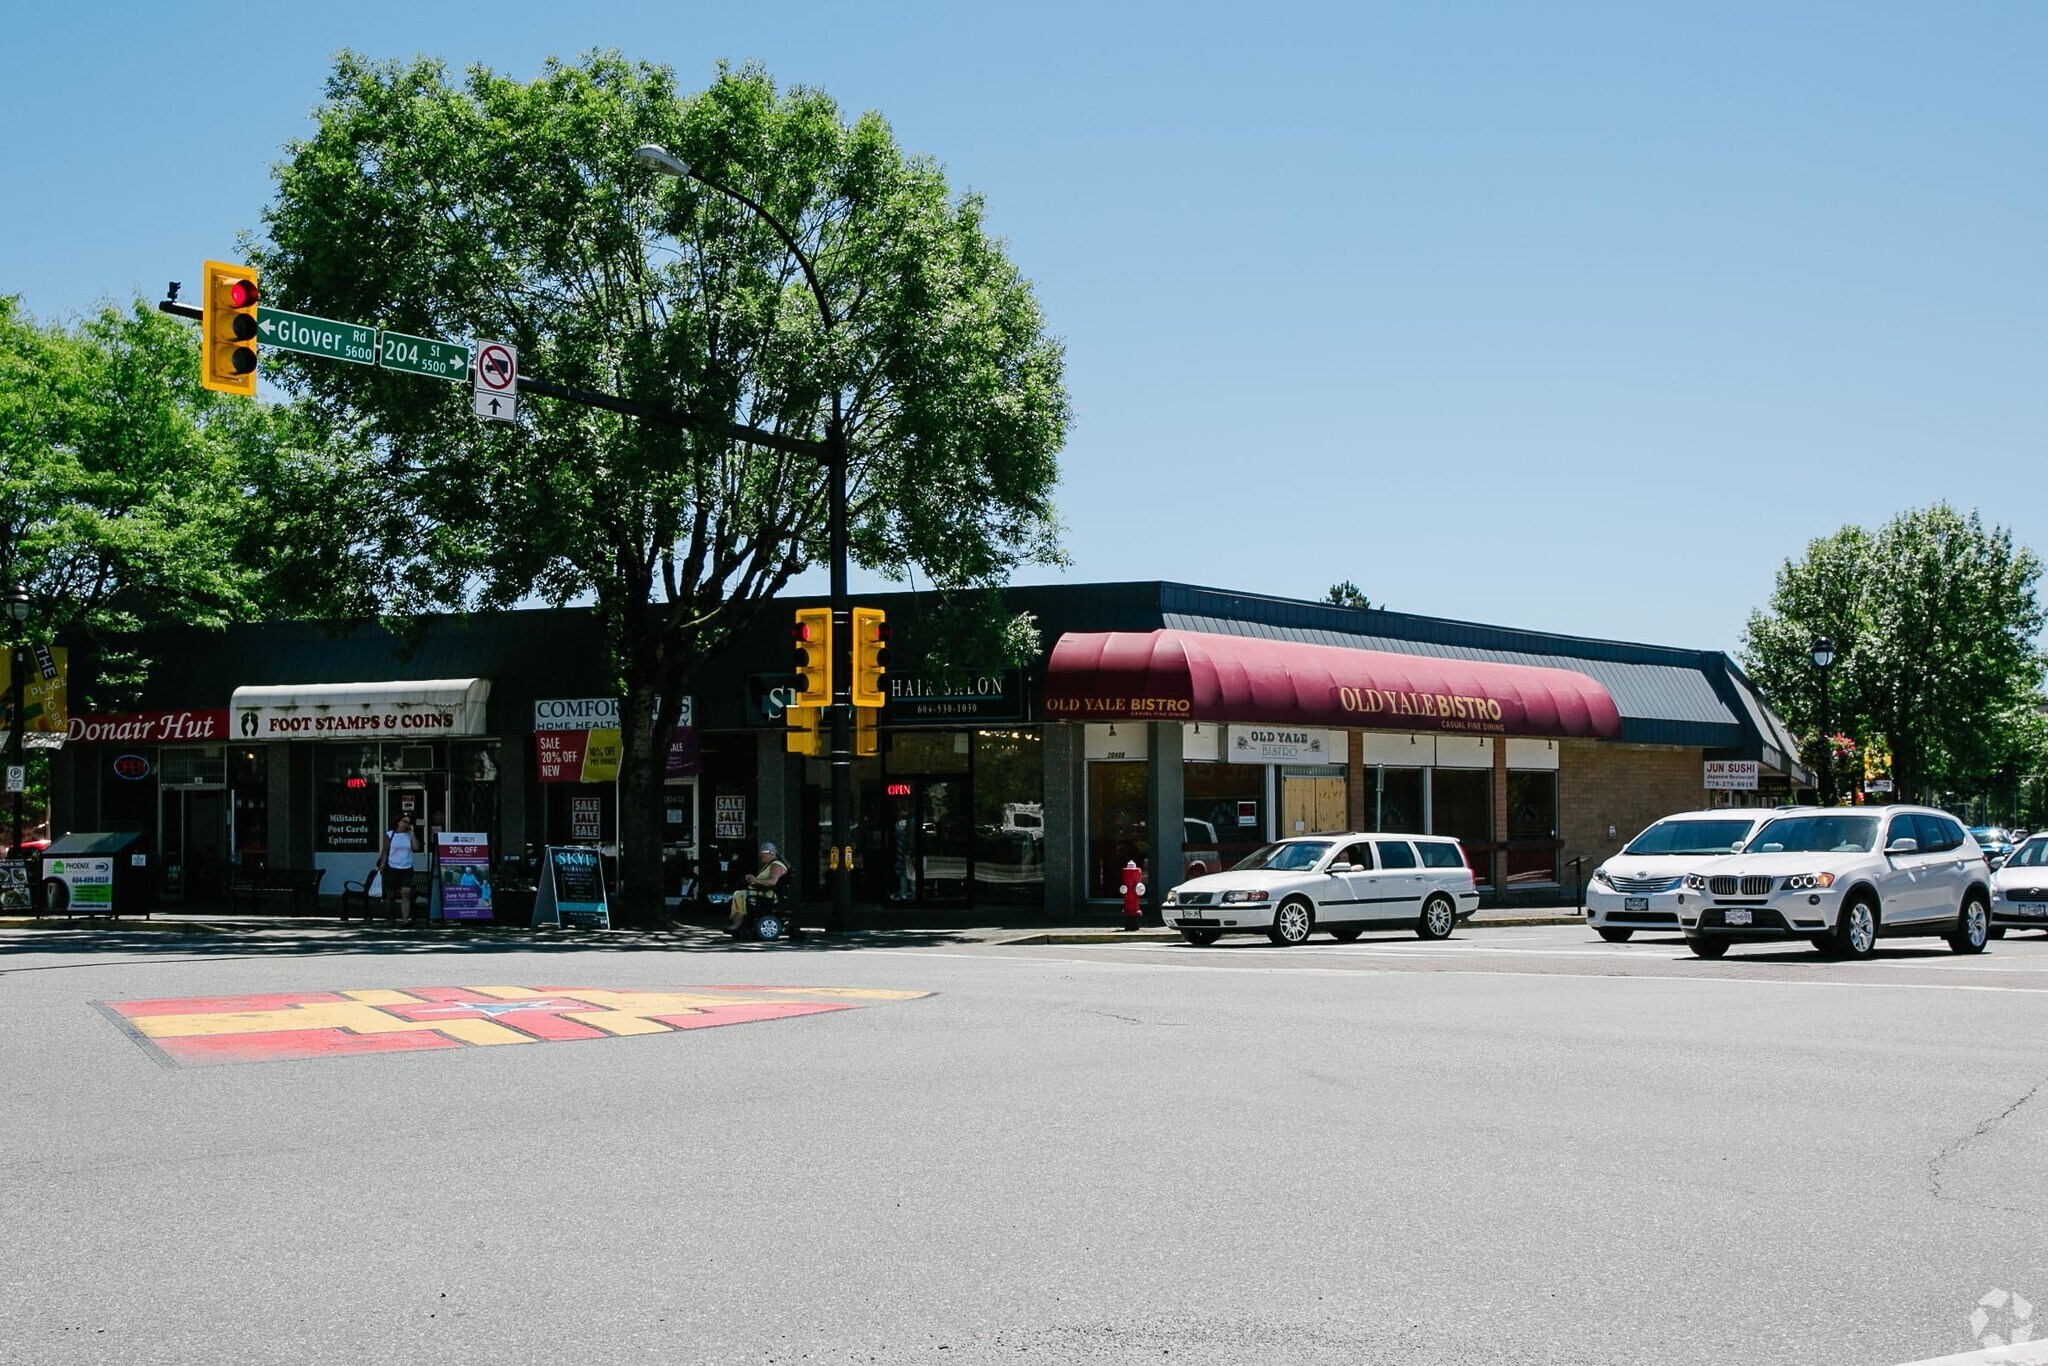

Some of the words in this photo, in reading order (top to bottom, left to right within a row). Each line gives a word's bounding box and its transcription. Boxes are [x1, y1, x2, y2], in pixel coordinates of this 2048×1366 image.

[278, 320, 342, 352] Glover
[353, 330, 366, 344] Rd
[345, 344, 372, 361] 5600
[385, 340, 418, 364] 204
[430, 344, 441, 357] St
[422, 358, 446, 374] 5500
[36, 645, 56, 678] THE
[30, 677, 67, 697] PLACE
[892, 679, 934, 696] HAIR
[944, 677, 1002, 696] SALON
[918, 703, 977, 713] 604-530-1030
[1047, 698, 1079, 711] OLD
[1084, 698, 1126, 711] YALE
[1131, 698, 1190, 712] BISTRO
[1340, 686, 1383, 712] OLD
[1383, 691, 1437, 716] YALE
[1438, 695, 1501, 720] BISTRO
[51, 712, 63, 727] BE
[269, 717, 312, 732] FOOT
[316, 715, 380, 730] STAMPS
[384, 714, 397, 728] &
[401, 713, 454, 728] COINS
[66, 714, 156, 741] Donair
[158, 712, 214, 740] Hut
[538, 722, 570, 730] HOME
[576, 721, 620, 729] HEALTH
[1442, 720, 1466, 729] CASUAL
[1467, 722, 1481, 730] FINE
[1483, 723, 1504, 731] DINING
[540, 738, 560, 749] SALE
[1251, 732, 1275, 743] OLD
[1278, 733, 1308, 744] YALE
[604, 746, 616, 755] OFF
[670, 742, 684, 752] ALE
[1262, 746, 1297, 757] BISTRO
[542, 751, 561, 763] 20%
[562, 751, 578, 763] OFF
[542, 765, 560, 777] NEW
[1707, 763, 1724, 772] JUN
[1728, 763, 1755, 773] SUSHI
[348, 778, 366, 788] OPEN
[888, 785, 911, 795] OPEN
[574, 801, 598, 811] SALE
[718, 799, 743, 809] SALE
[330, 814, 366, 823] Militairia
[574, 813, 598, 823] SALE
[718, 812, 743, 822] SALE
[328, 825, 343, 833] Post
[345, 825, 368, 834] Cards
[574, 825, 598, 836] SALE
[718, 824, 743, 835] SALE
[328, 836, 367, 845] Ephemera
[449, 846, 463, 854] 20%
[464, 846, 478, 854] OFF
